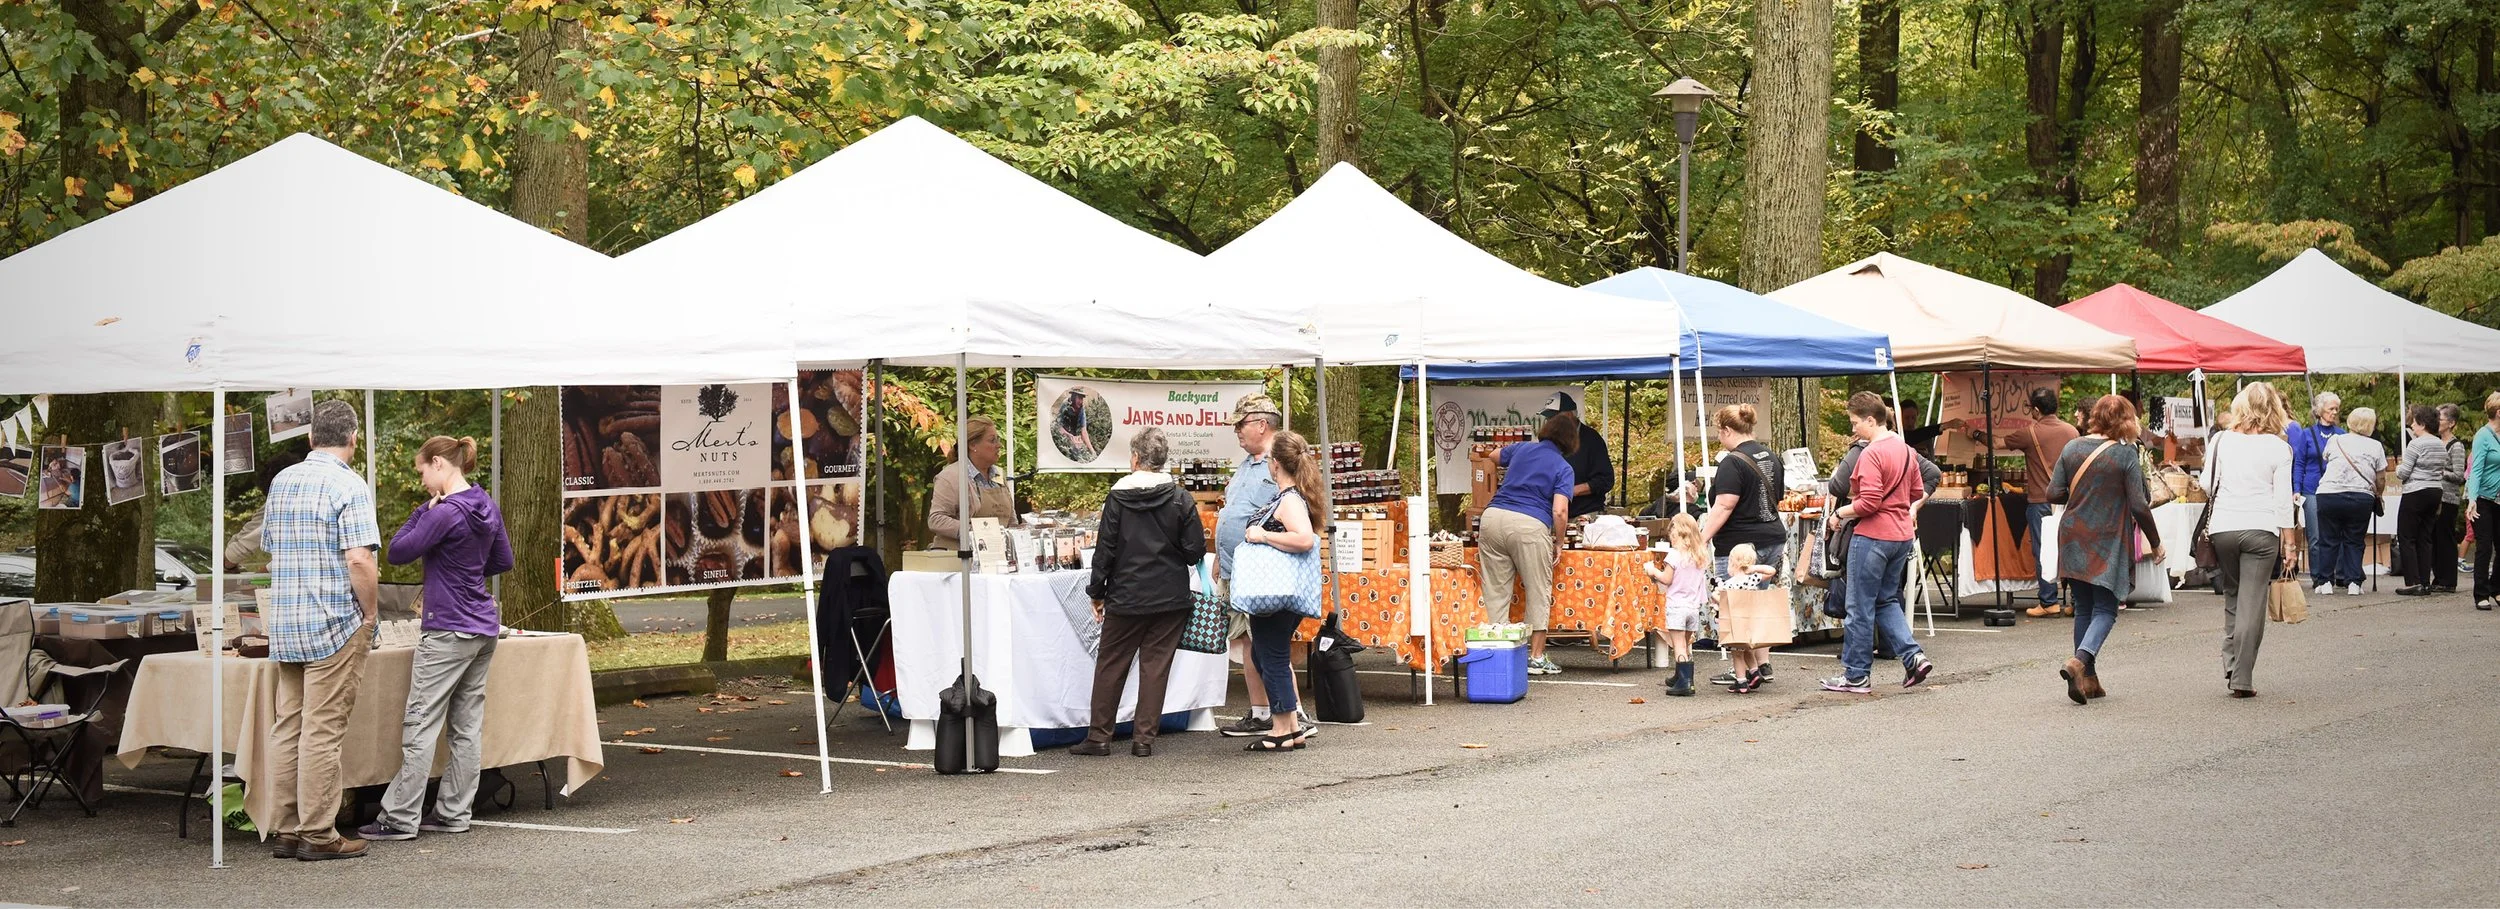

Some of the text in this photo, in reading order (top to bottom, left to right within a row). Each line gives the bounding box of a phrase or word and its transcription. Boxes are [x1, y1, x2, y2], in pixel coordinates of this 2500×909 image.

[1167, 390, 1219, 405] Backyard
[1681, 389, 1713, 403] Artian
[1714, 389, 1738, 407] Jarred
[1122, 406, 1232, 427] JAMS AND JELL
[672, 421, 759, 451] Mert's
[700, 452, 738, 463] NUTS
[824, 464, 857, 474] GOURMET
[564, 476, 595, 486] CLASSIC
[703, 569, 729, 579] SINFUL
[566, 580, 602, 590] PRETZELS
